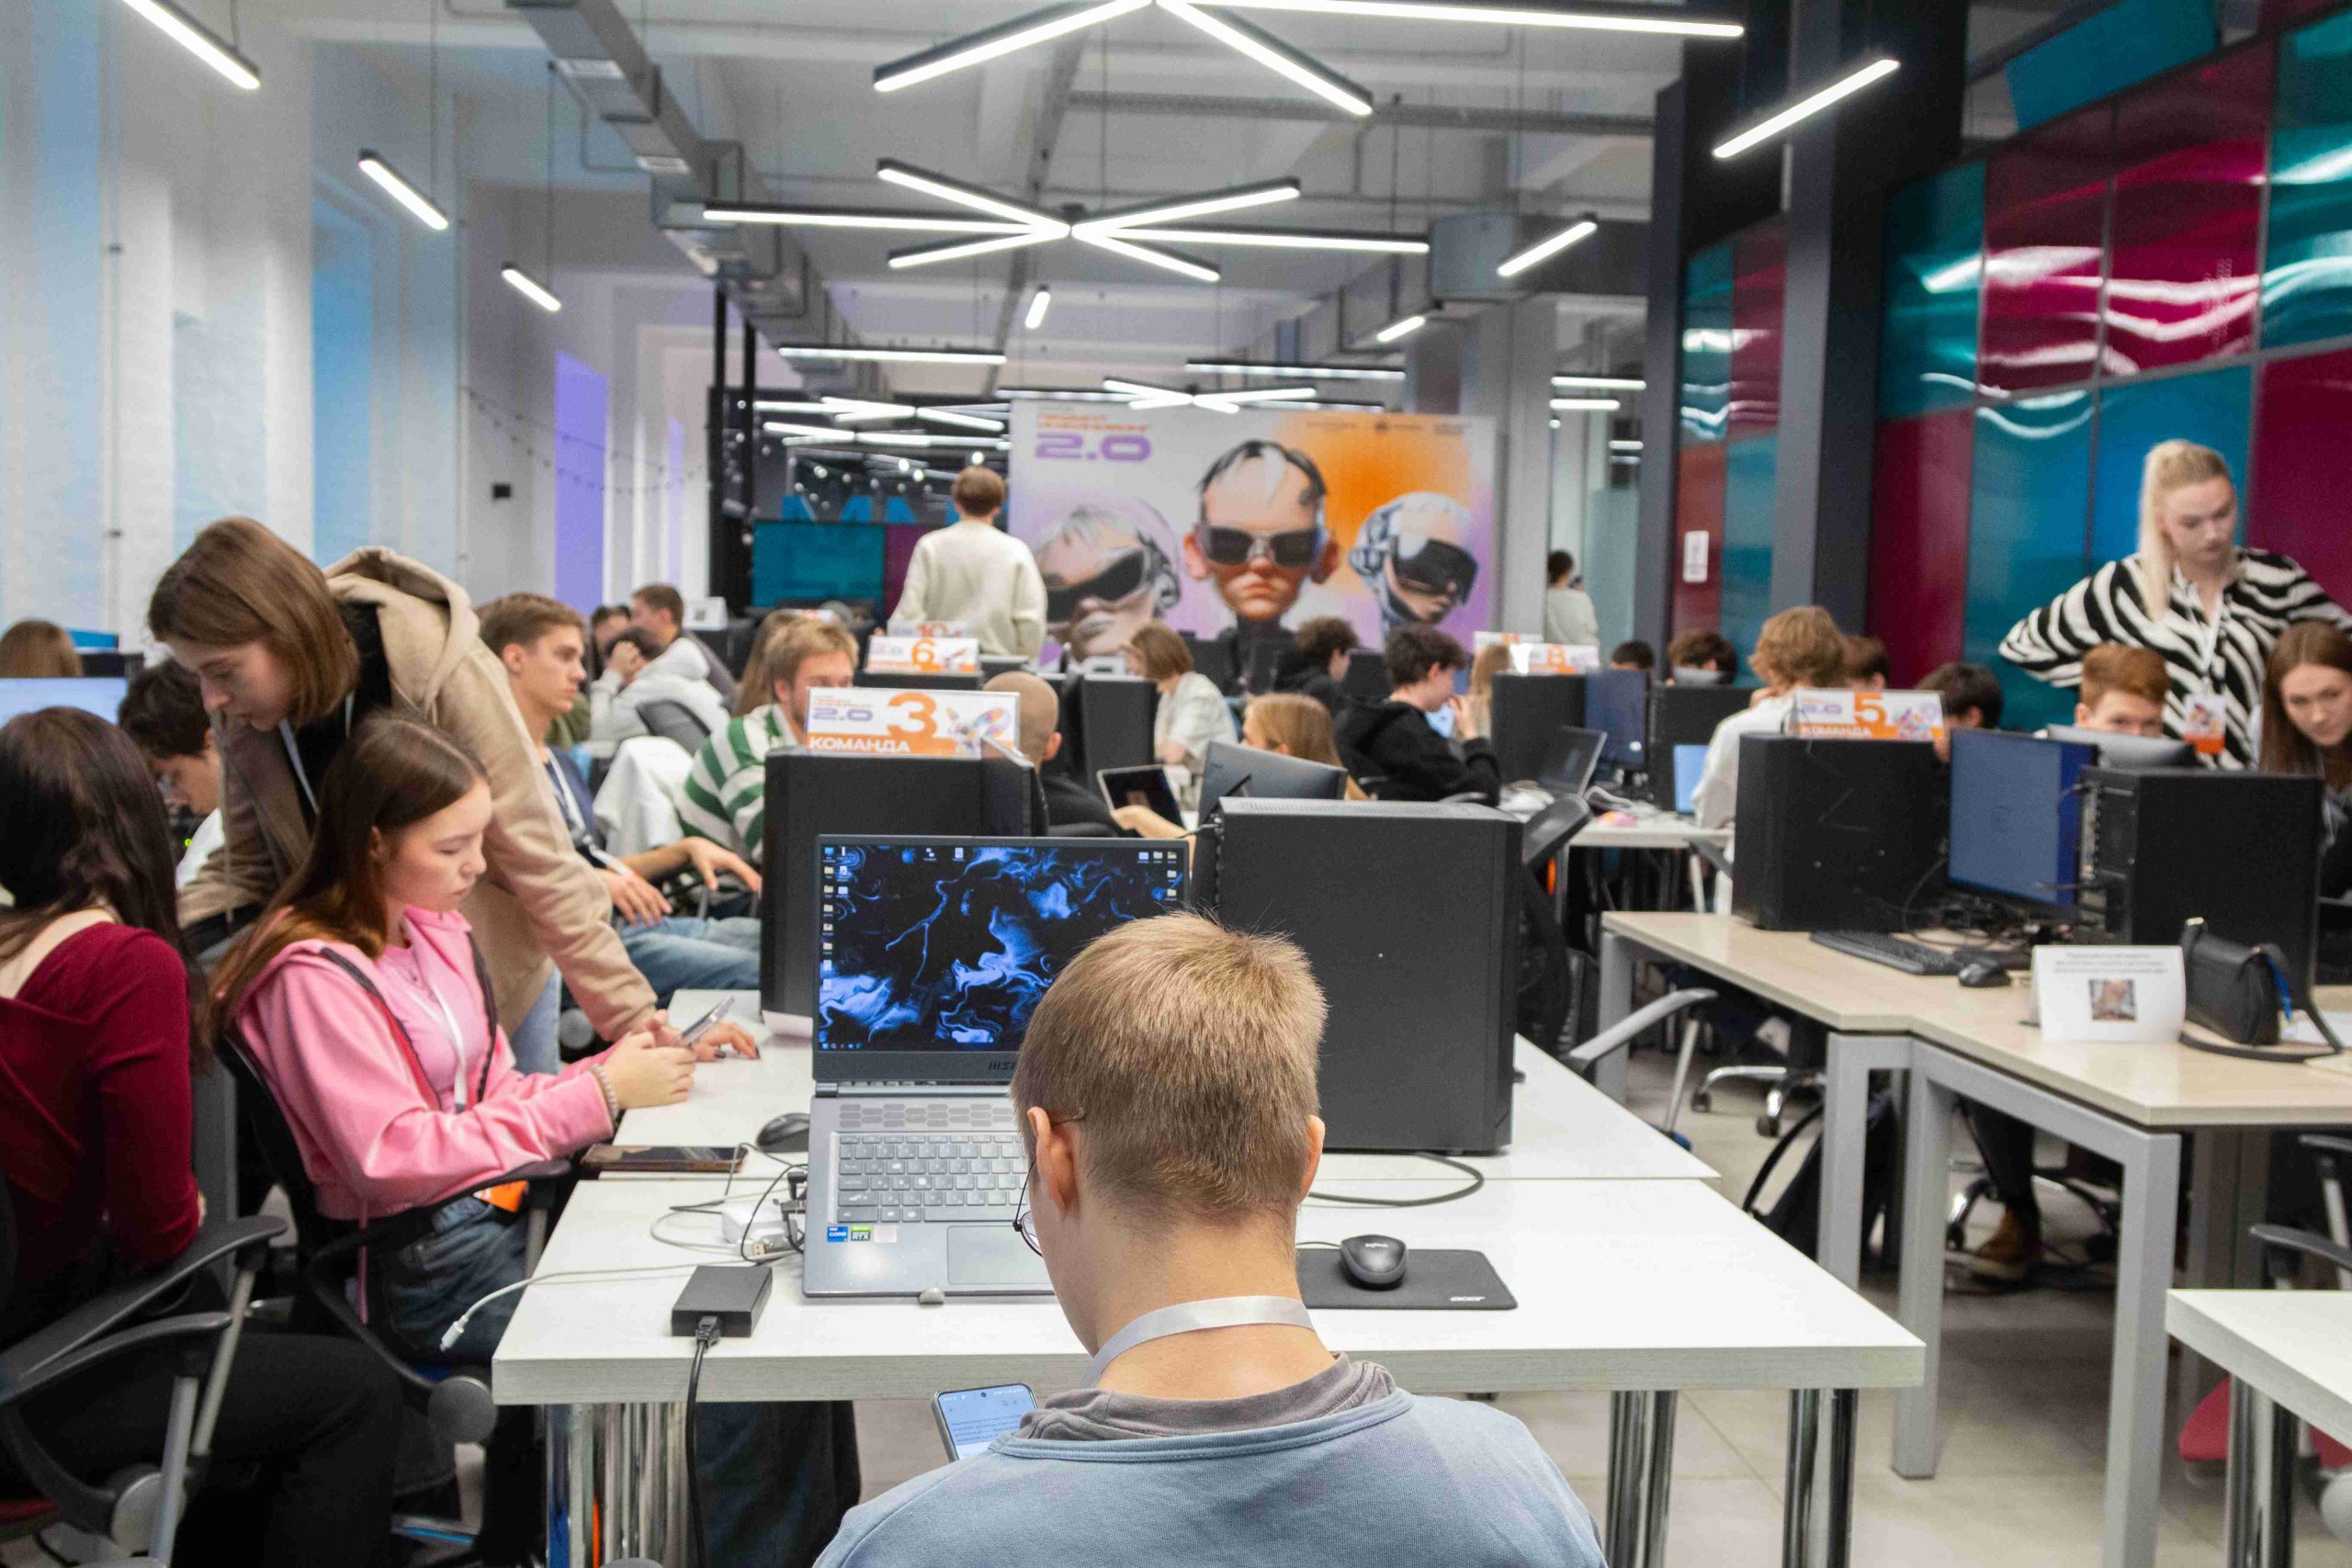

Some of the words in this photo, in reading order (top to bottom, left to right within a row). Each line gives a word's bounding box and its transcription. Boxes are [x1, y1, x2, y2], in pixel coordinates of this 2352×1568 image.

[1035, 433, 1151, 461] 2.0
[911, 637, 934, 669] 6
[813, 708, 873, 721] 2.0
[887, 692, 936, 738] 3
[1854, 691, 1885, 730] 5
[809, 736, 910, 752] КОМАНДА
